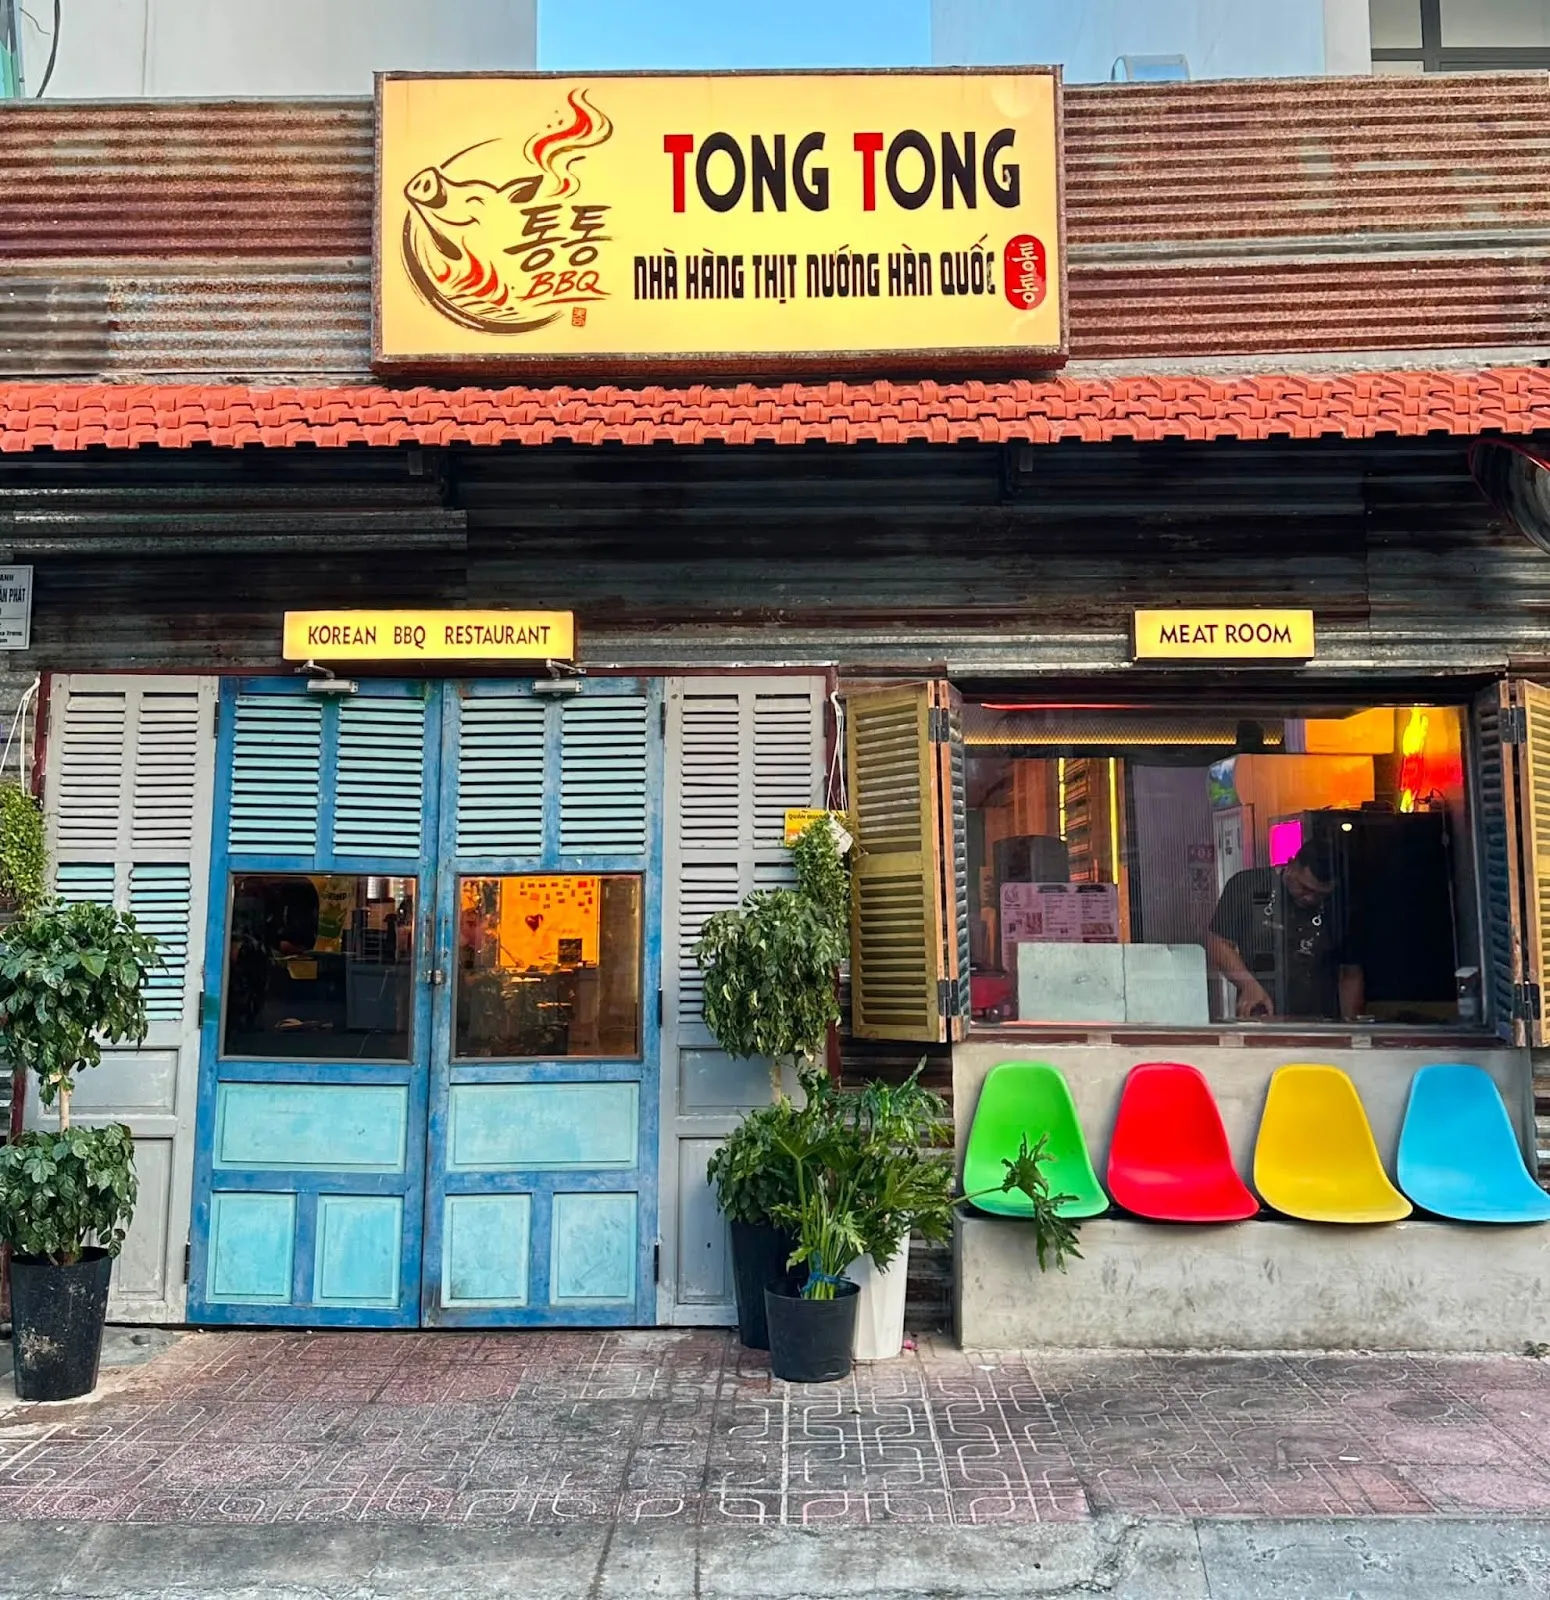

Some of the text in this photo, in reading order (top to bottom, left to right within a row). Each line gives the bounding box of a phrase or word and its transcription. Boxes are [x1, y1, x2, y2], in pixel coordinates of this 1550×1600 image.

[664, 128, 1020, 213] TONG TONG
[503, 203, 613, 273] 통통
[517, 270, 612, 300] BBQ
[634, 233, 996, 304] NHÀ HÀNG THỊT NƯỚNG HÀN QUỐC
[308, 625, 550, 649] KOREAN BBQ RESTAURANT
[1160, 623, 1292, 644] MEAT ROOM
